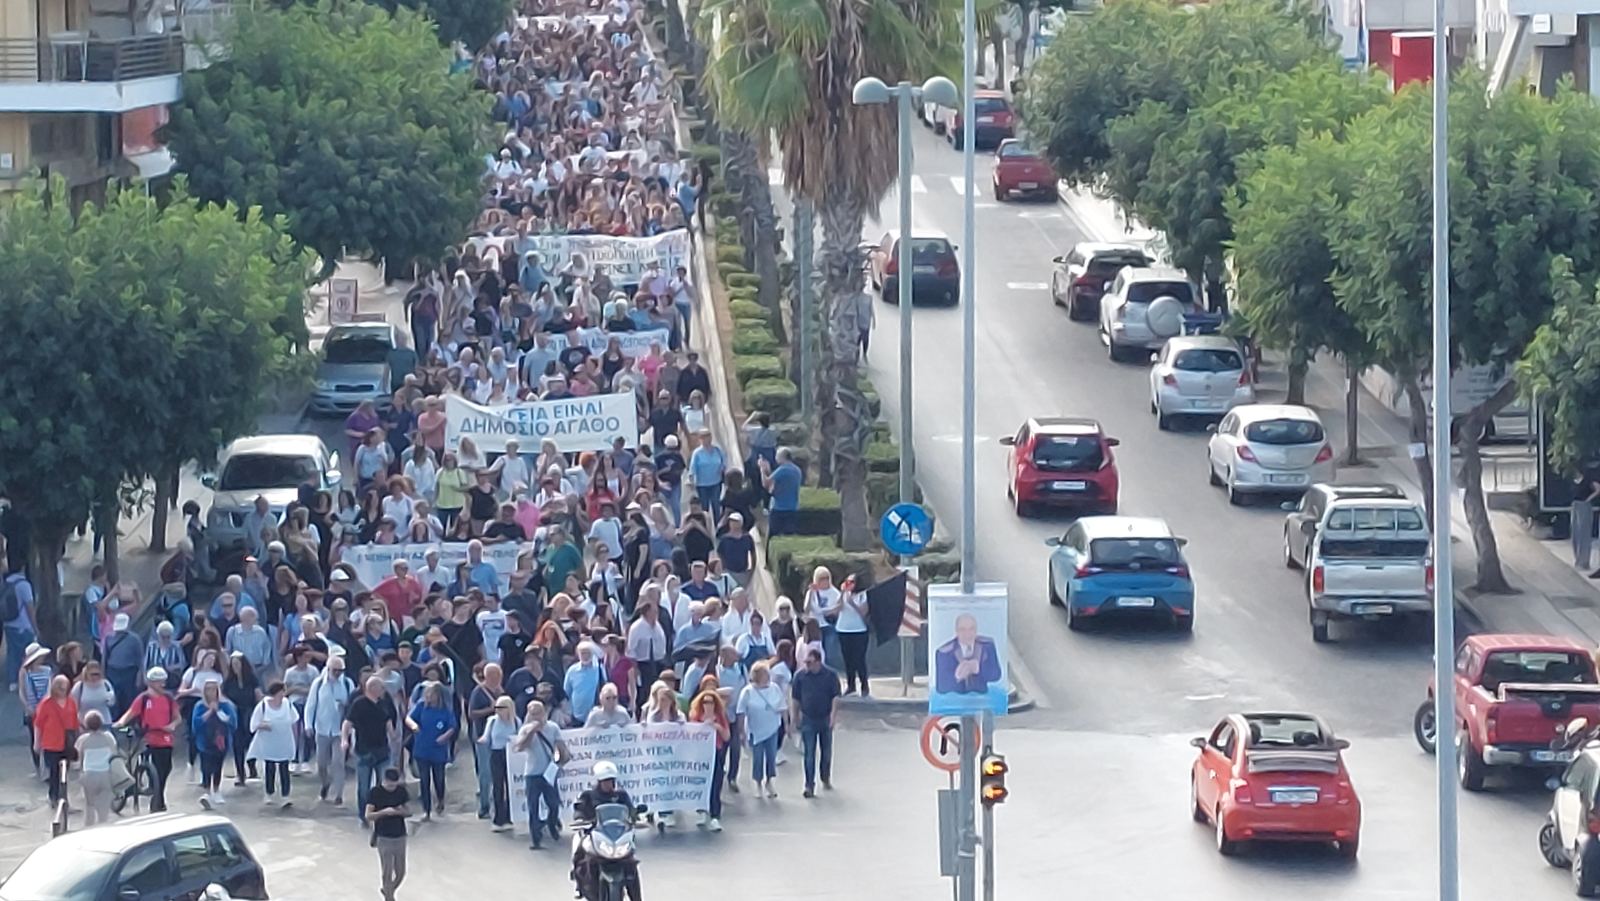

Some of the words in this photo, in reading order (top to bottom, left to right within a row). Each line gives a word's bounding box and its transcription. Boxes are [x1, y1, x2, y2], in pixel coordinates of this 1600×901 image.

[553, 400, 603, 419] ΕΙΝΑΙ
[459, 416, 550, 436] ΔΗΜΟΣΙΟ
[553, 416, 620, 435] ΑΓΑΘΟ
